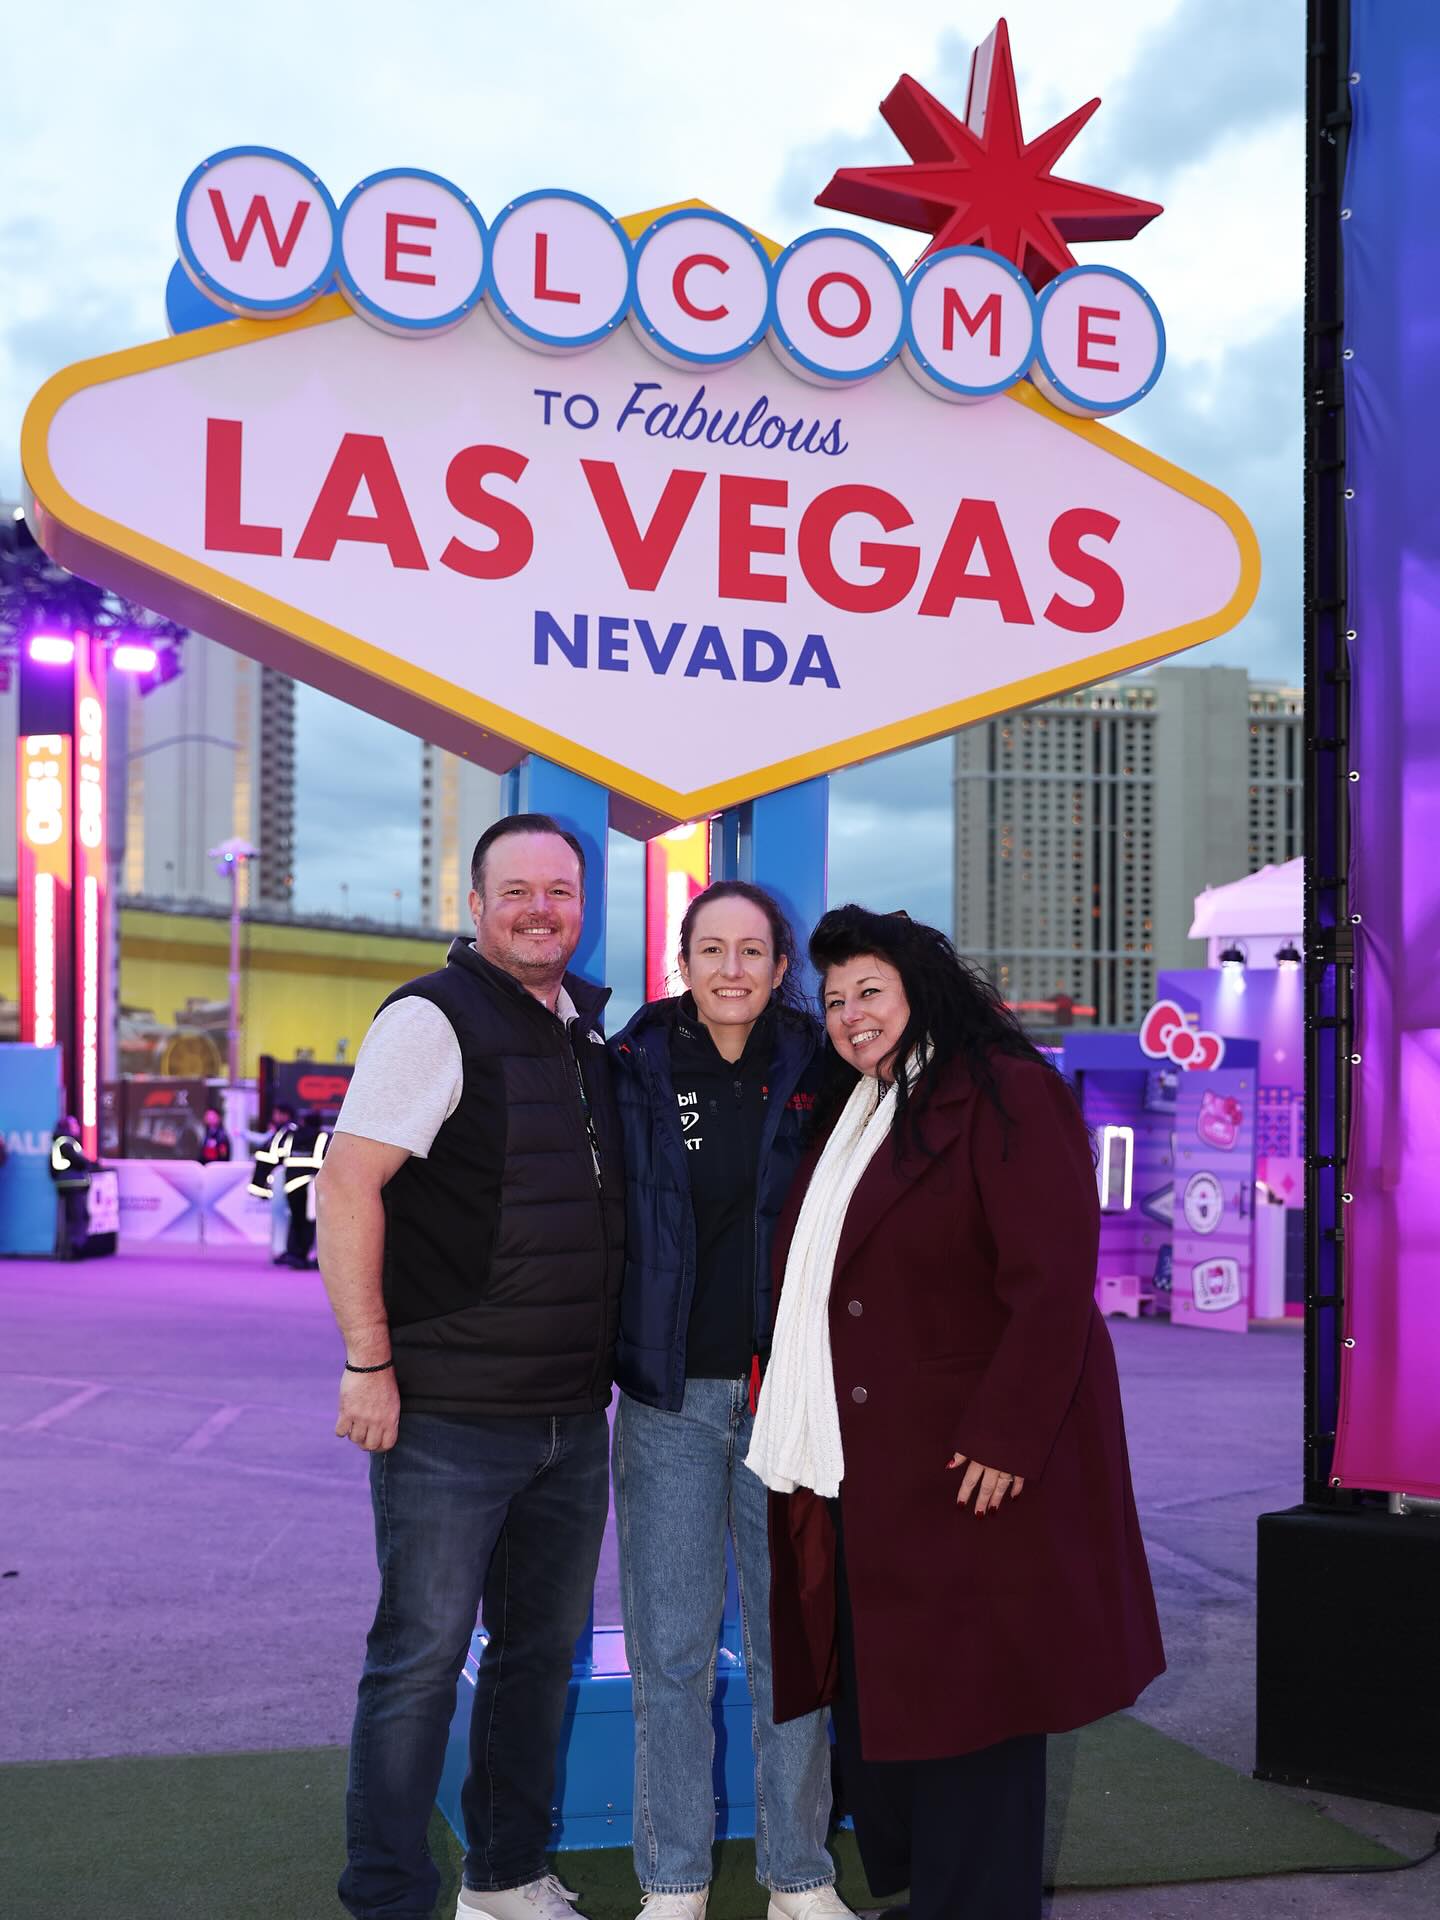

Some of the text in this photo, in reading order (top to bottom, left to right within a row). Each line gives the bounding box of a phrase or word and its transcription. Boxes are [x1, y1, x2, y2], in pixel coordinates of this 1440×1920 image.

[208, 189, 1120, 372] WELCOME
[534, 382, 848, 456] TO Fabulous
[205, 418, 1125, 634] LAS VEGAS
[534, 610, 841, 690] NEVADA
